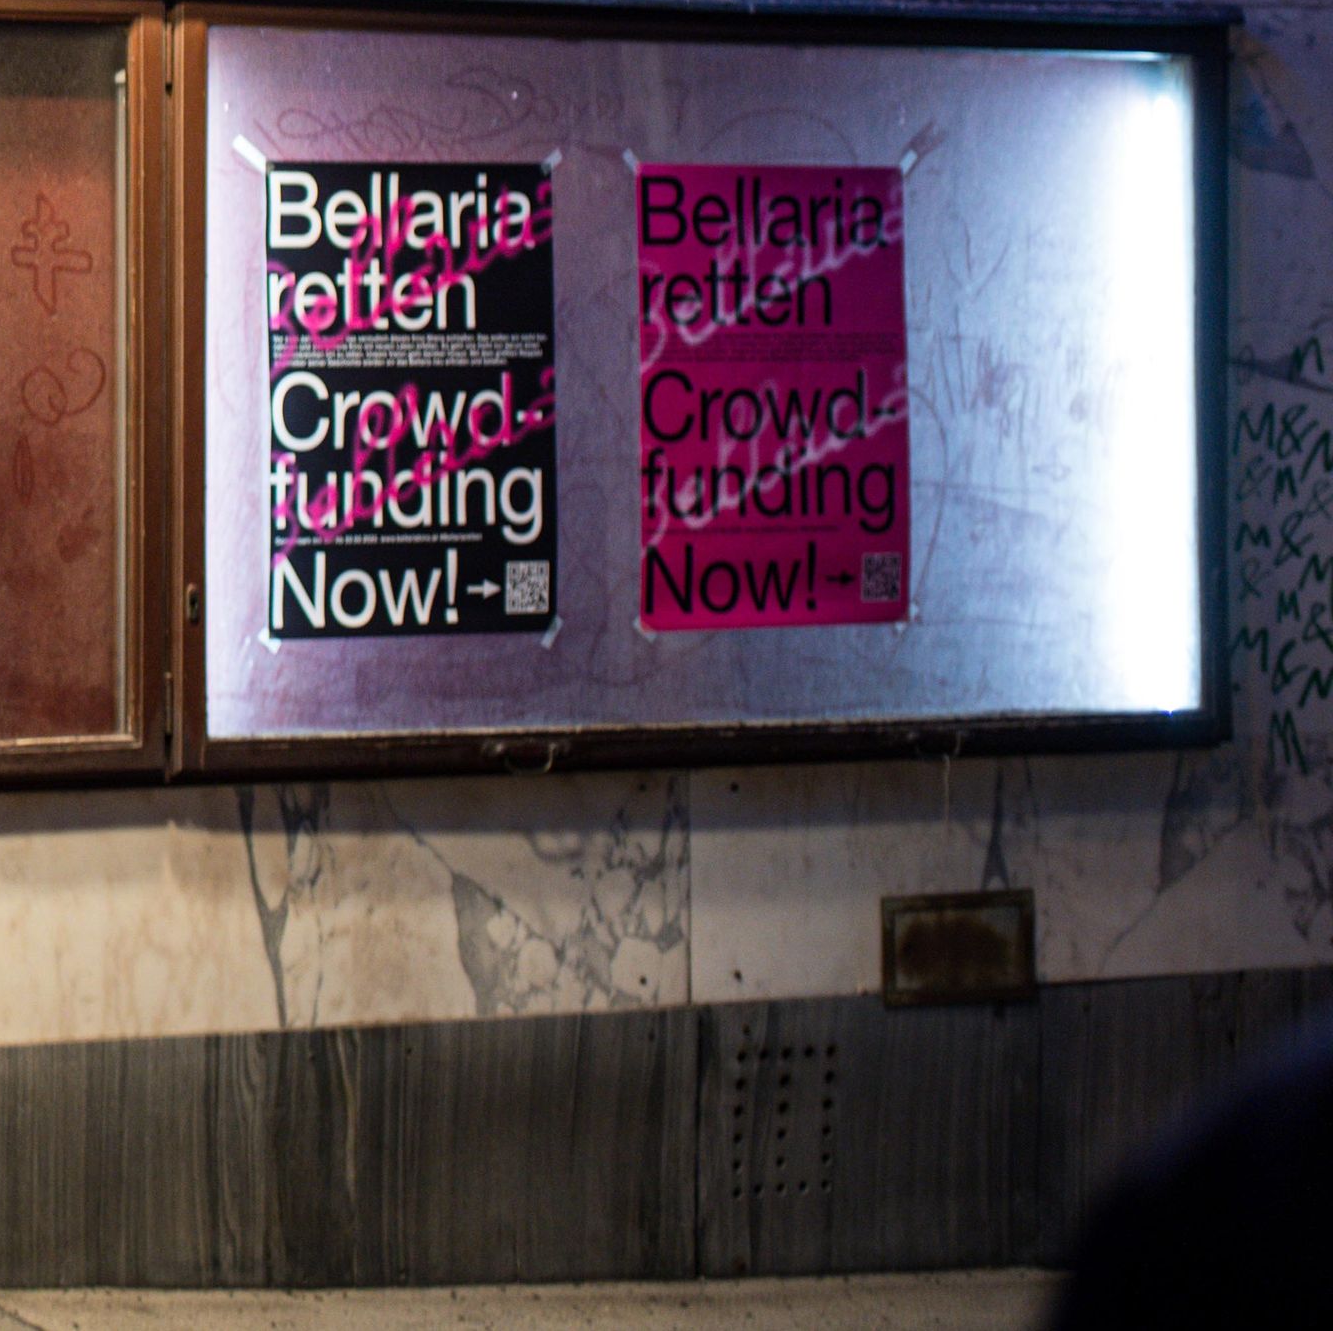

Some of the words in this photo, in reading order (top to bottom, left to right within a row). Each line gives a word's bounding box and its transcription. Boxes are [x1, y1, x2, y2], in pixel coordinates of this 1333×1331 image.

[268, 170, 537, 250] Bellaria
[639, 175, 889, 249] Bellaria
[268, 257, 477, 331] retten
[640, 258, 833, 327] retten
[270, 370, 545, 453] Crowd-
[642, 368, 898, 443] Crowd-
[269, 450, 544, 545] funding
[641, 446, 897, 536] funding
[272, 548, 460, 630] Now!
[644, 540, 818, 616] Now!
